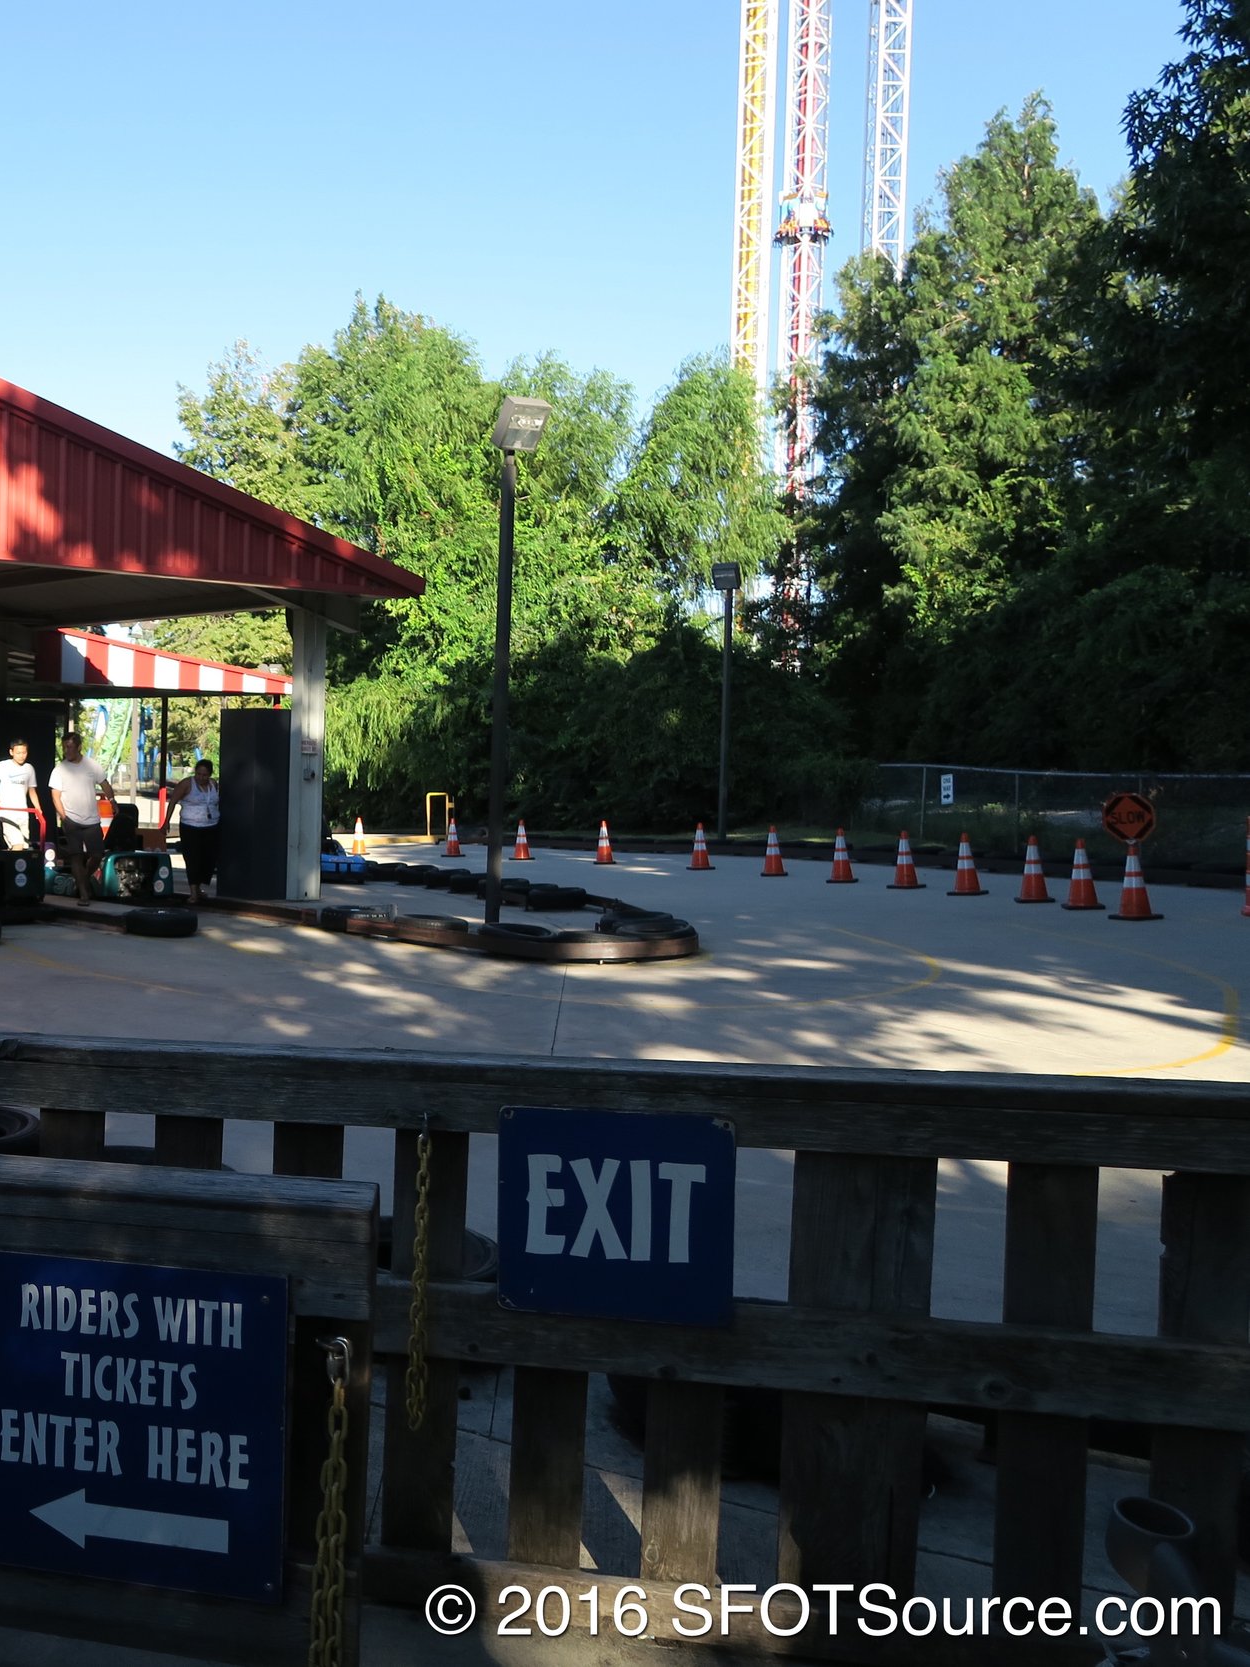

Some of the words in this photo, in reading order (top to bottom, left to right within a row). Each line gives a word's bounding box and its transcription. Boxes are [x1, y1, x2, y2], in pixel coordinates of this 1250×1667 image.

[1111, 811, 1145, 825] SLOW
[526, 1154, 707, 1263] EXIT
[20, 1282, 141, 1338] RIDERS
[153, 1296, 243, 1349] WITH
[60, 1351, 198, 1410] TICKETS
[0, 1409, 123, 1476] ENTER
[148, 1424, 250, 1490] HERE
